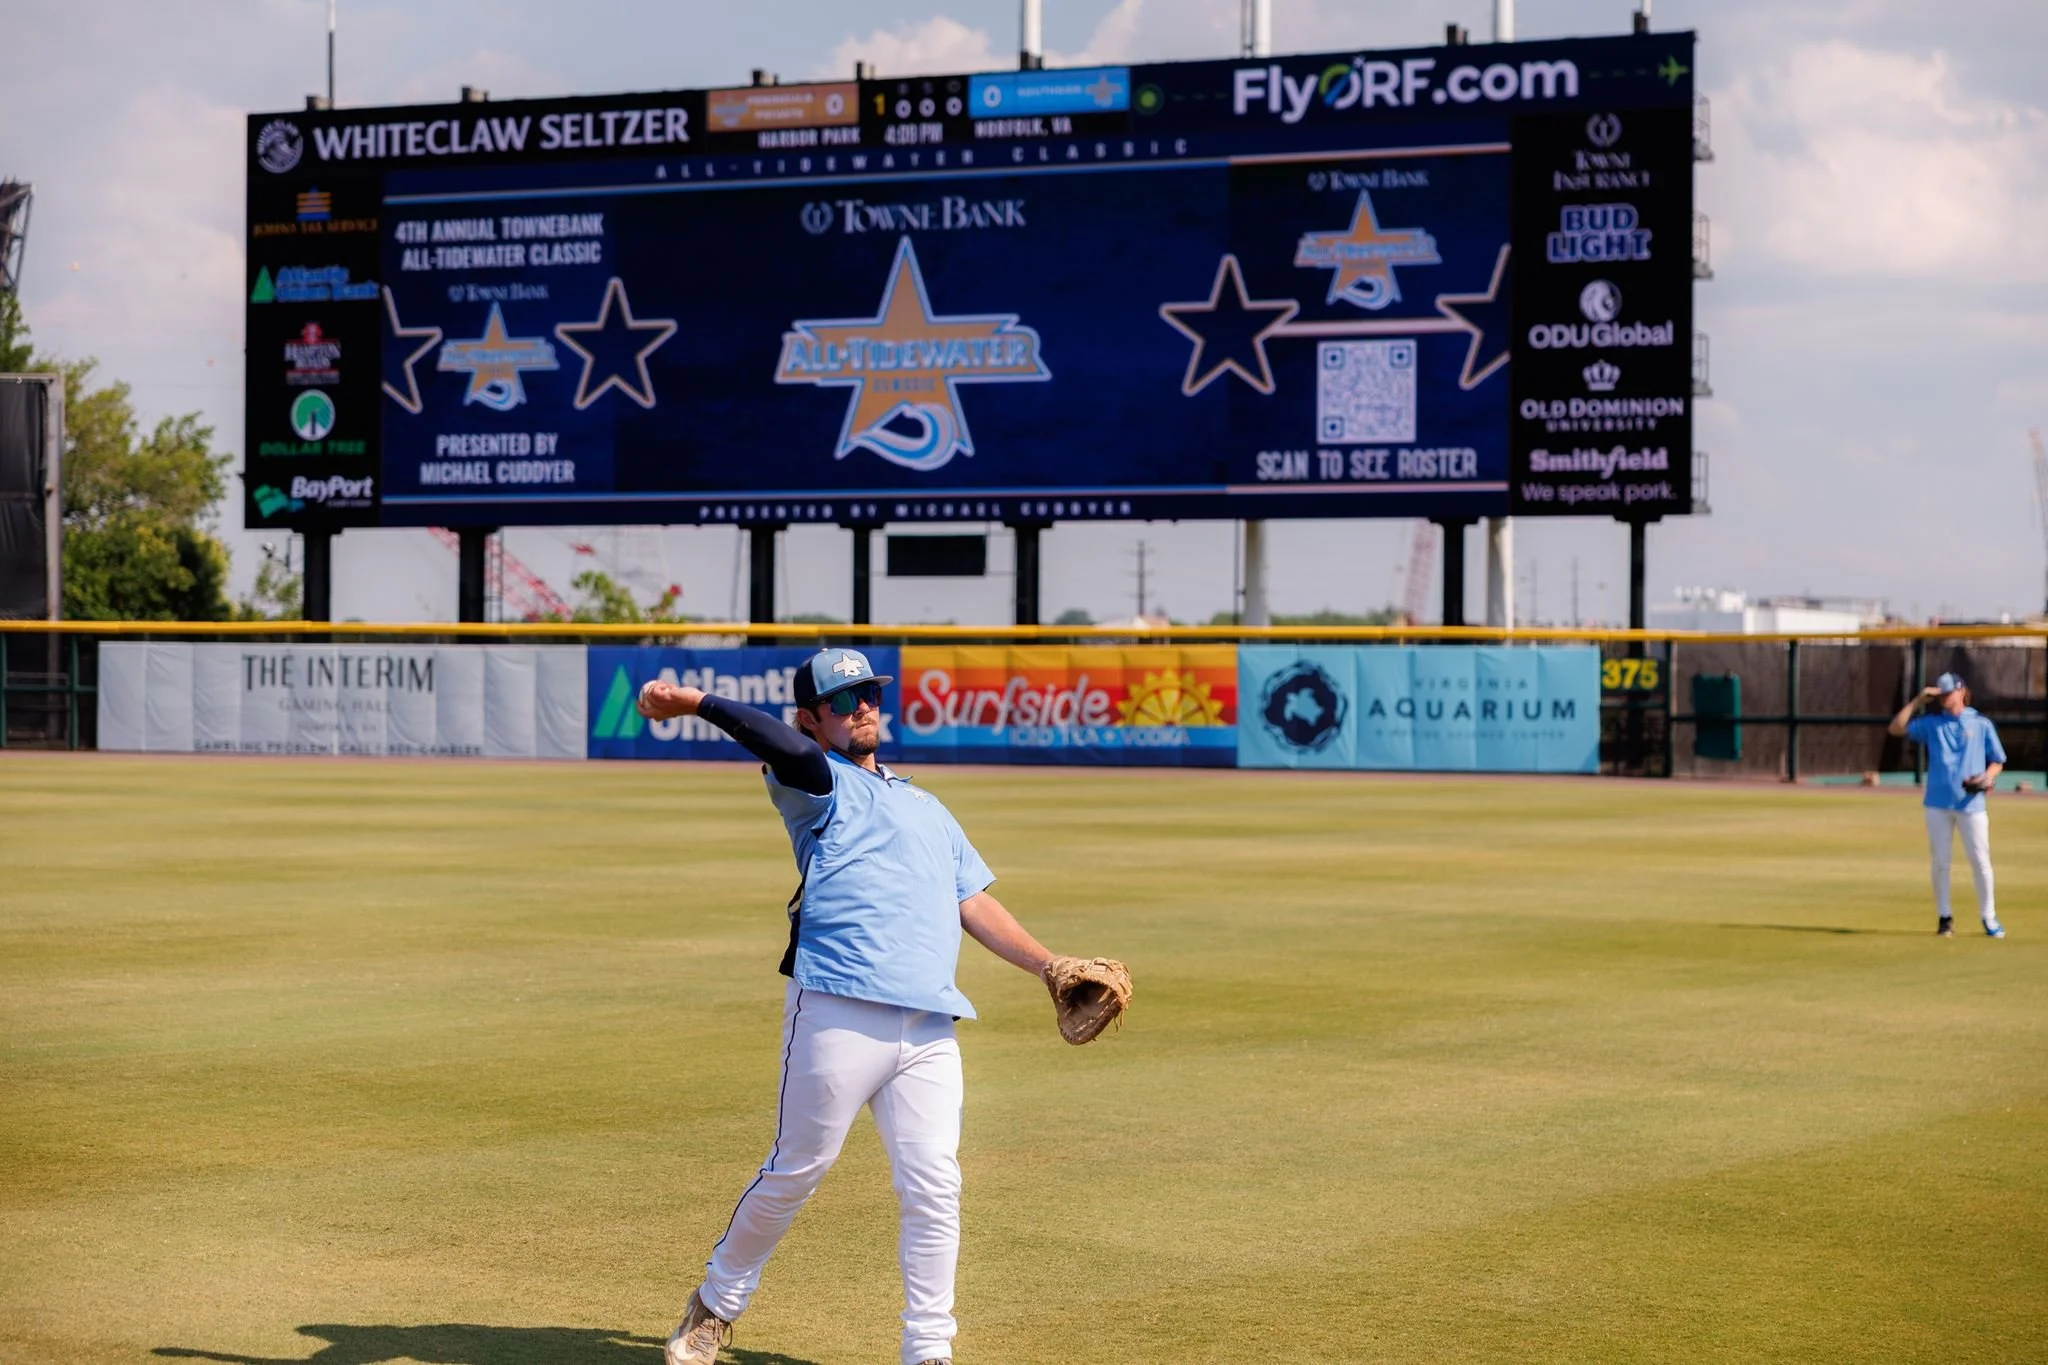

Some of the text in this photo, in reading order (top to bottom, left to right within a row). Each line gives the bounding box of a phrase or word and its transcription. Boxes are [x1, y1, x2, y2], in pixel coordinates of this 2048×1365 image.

[983, 85, 1002, 108] 0
[1233, 58, 1579, 123] FlyORF.com
[824, 93, 845, 117] 0
[873, 93, 962, 119] 1 0 0 0
[312, 115, 532, 161] WHITECLAW
[539, 108, 690, 151] SELTZER
[758, 126, 861, 149] HARBOR PARK
[919, 121, 944, 144] PM
[974, 116, 1073, 139] NORFOLK, VA
[655, 138, 1188, 179] ALL-TIDEWATER CLASSIC
[394, 212, 604, 244] 4TH ANNUAL TOWNEBANK
[1563, 204, 1637, 232] BUD
[401, 241, 602, 271] ALL-TIDEWATER CLASSIC
[1549, 232, 1650, 260] LIGHT
[1520, 396, 1684, 420] OLD DOMINION
[1546, 417, 1657, 433] UNIVERSITY
[436, 431, 558, 457] PRESENTED BY
[419, 459, 575, 486] MICHAEL CUDDYER
[1256, 447, 1478, 480] SCAN TO SEE ROSTER
[1529, 444, 1669, 480] Smithfield
[291, 475, 373, 503] BayPort
[1521, 483, 1555, 501] We
[1557, 480, 1621, 506] speak
[241, 653, 435, 693] THE INTERIM
[656, 666, 797, 705] Atlanti
[1414, 678, 1529, 690] VIRGINIA
[1602, 658, 1659, 690] 375
[278, 698, 345, 713] GAMING
[906, 668, 1111, 736] Surfside
[1368, 697, 1576, 721] AQUARIUM
